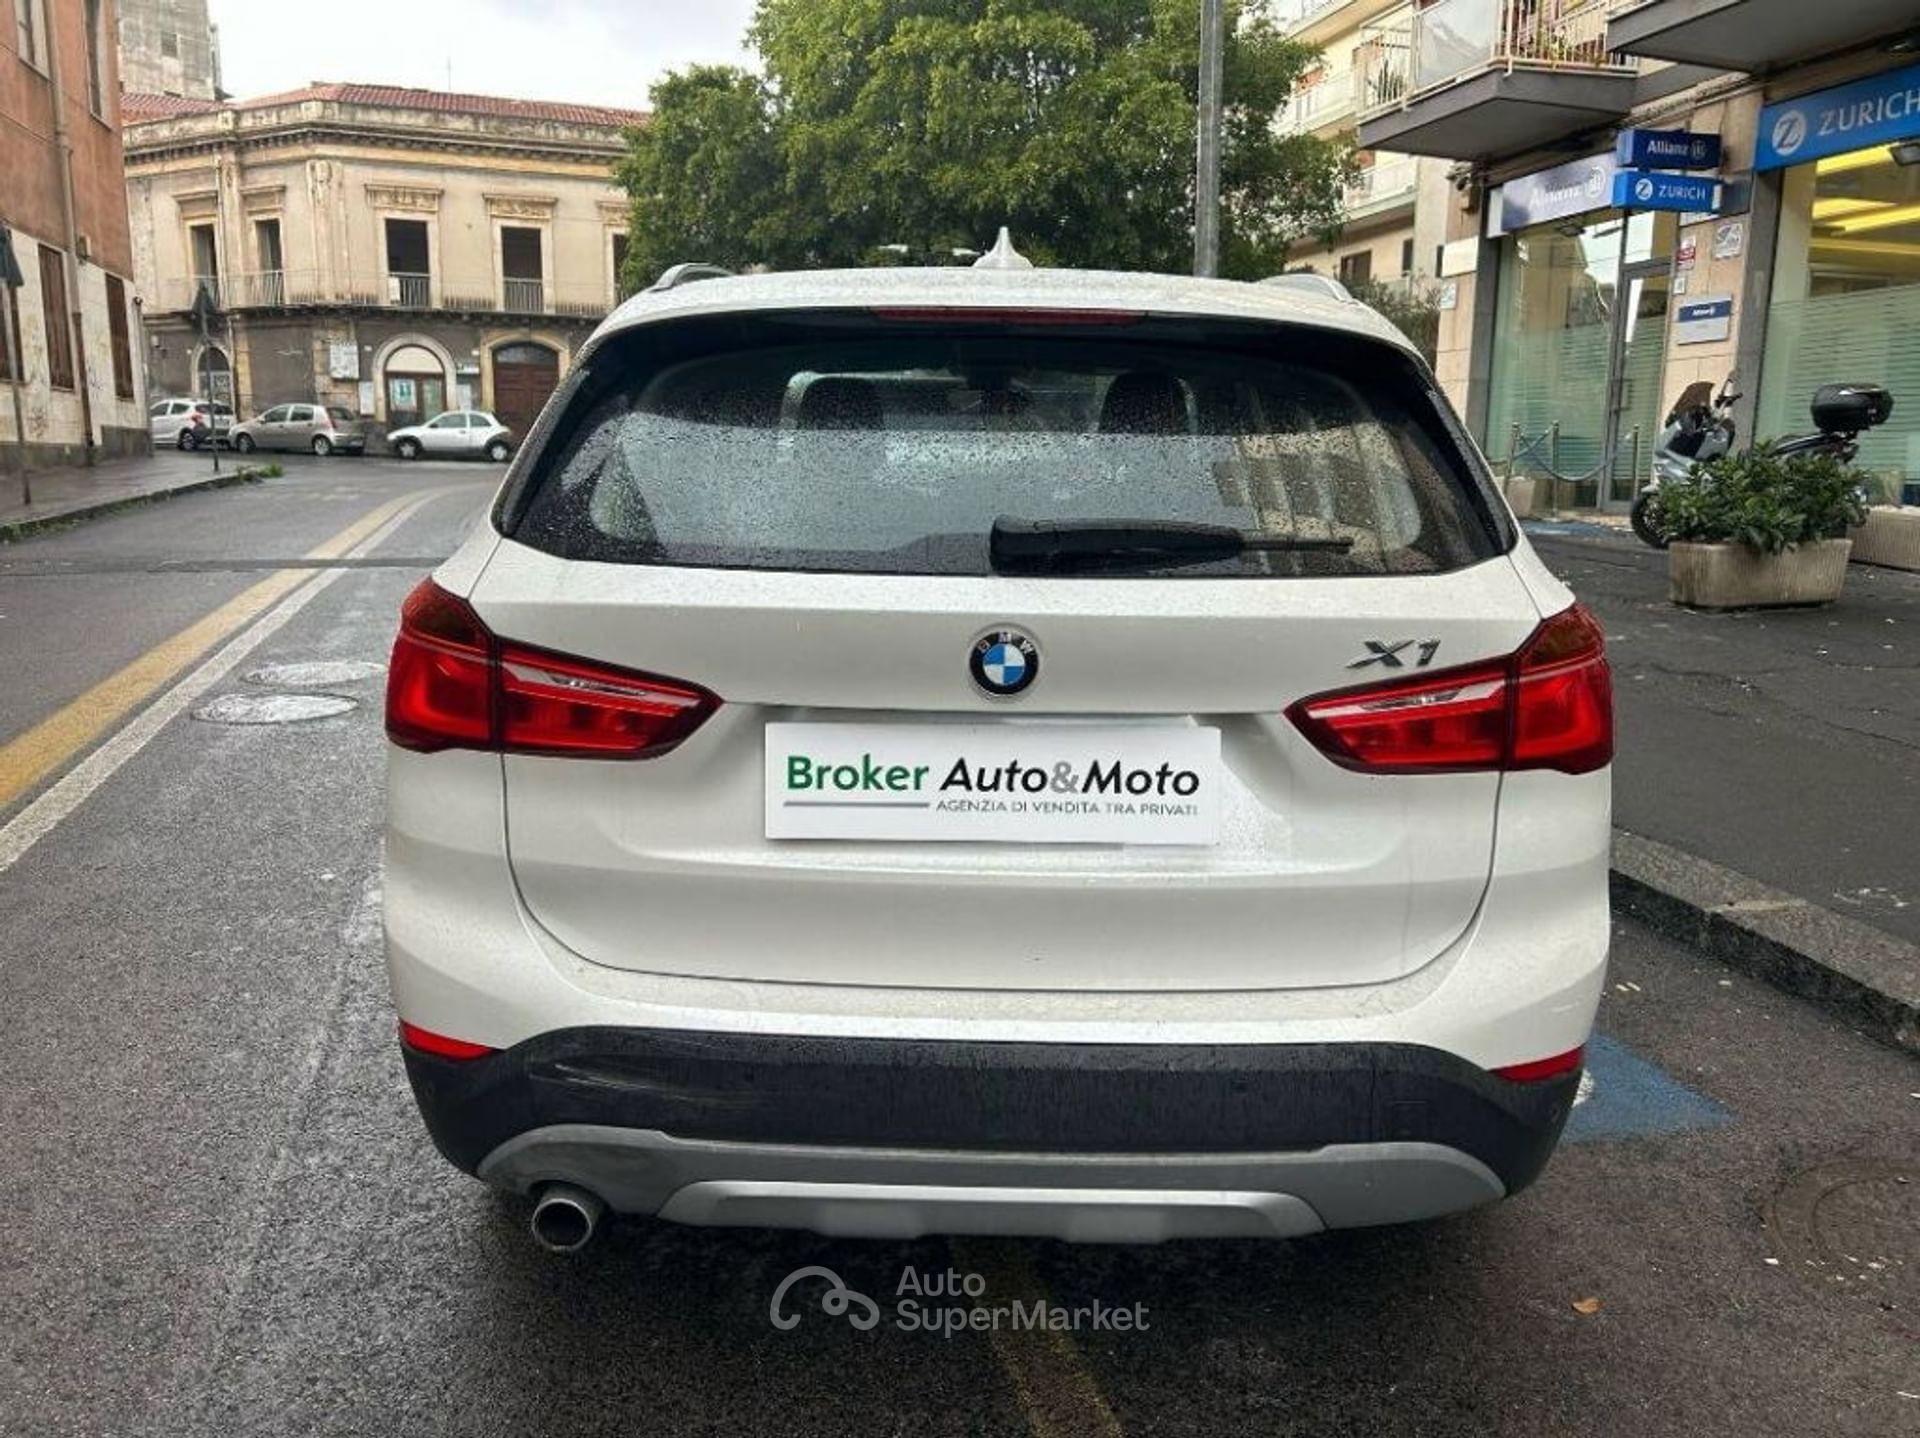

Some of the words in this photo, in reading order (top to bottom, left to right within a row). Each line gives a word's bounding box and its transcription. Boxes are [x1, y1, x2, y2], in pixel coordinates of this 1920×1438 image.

[1817, 89, 1920, 136] ZURICH
[1647, 140, 1690, 155] Allianz
[1658, 186, 1706, 200] ZURICH
[977, 632, 1035, 654] BMW
[1345, 638, 1441, 669] X1
[787, 753, 930, 790] Broker
[939, 756, 1200, 796] Auto&Moto
[936, 800, 1008, 812] AGENZIA
[1012, 801, 1027, 812] DI
[1032, 801, 1100, 814] VENDITA
[1106, 803, 1136, 815] TRA
[1140, 803, 1198, 816] PRIVATI
